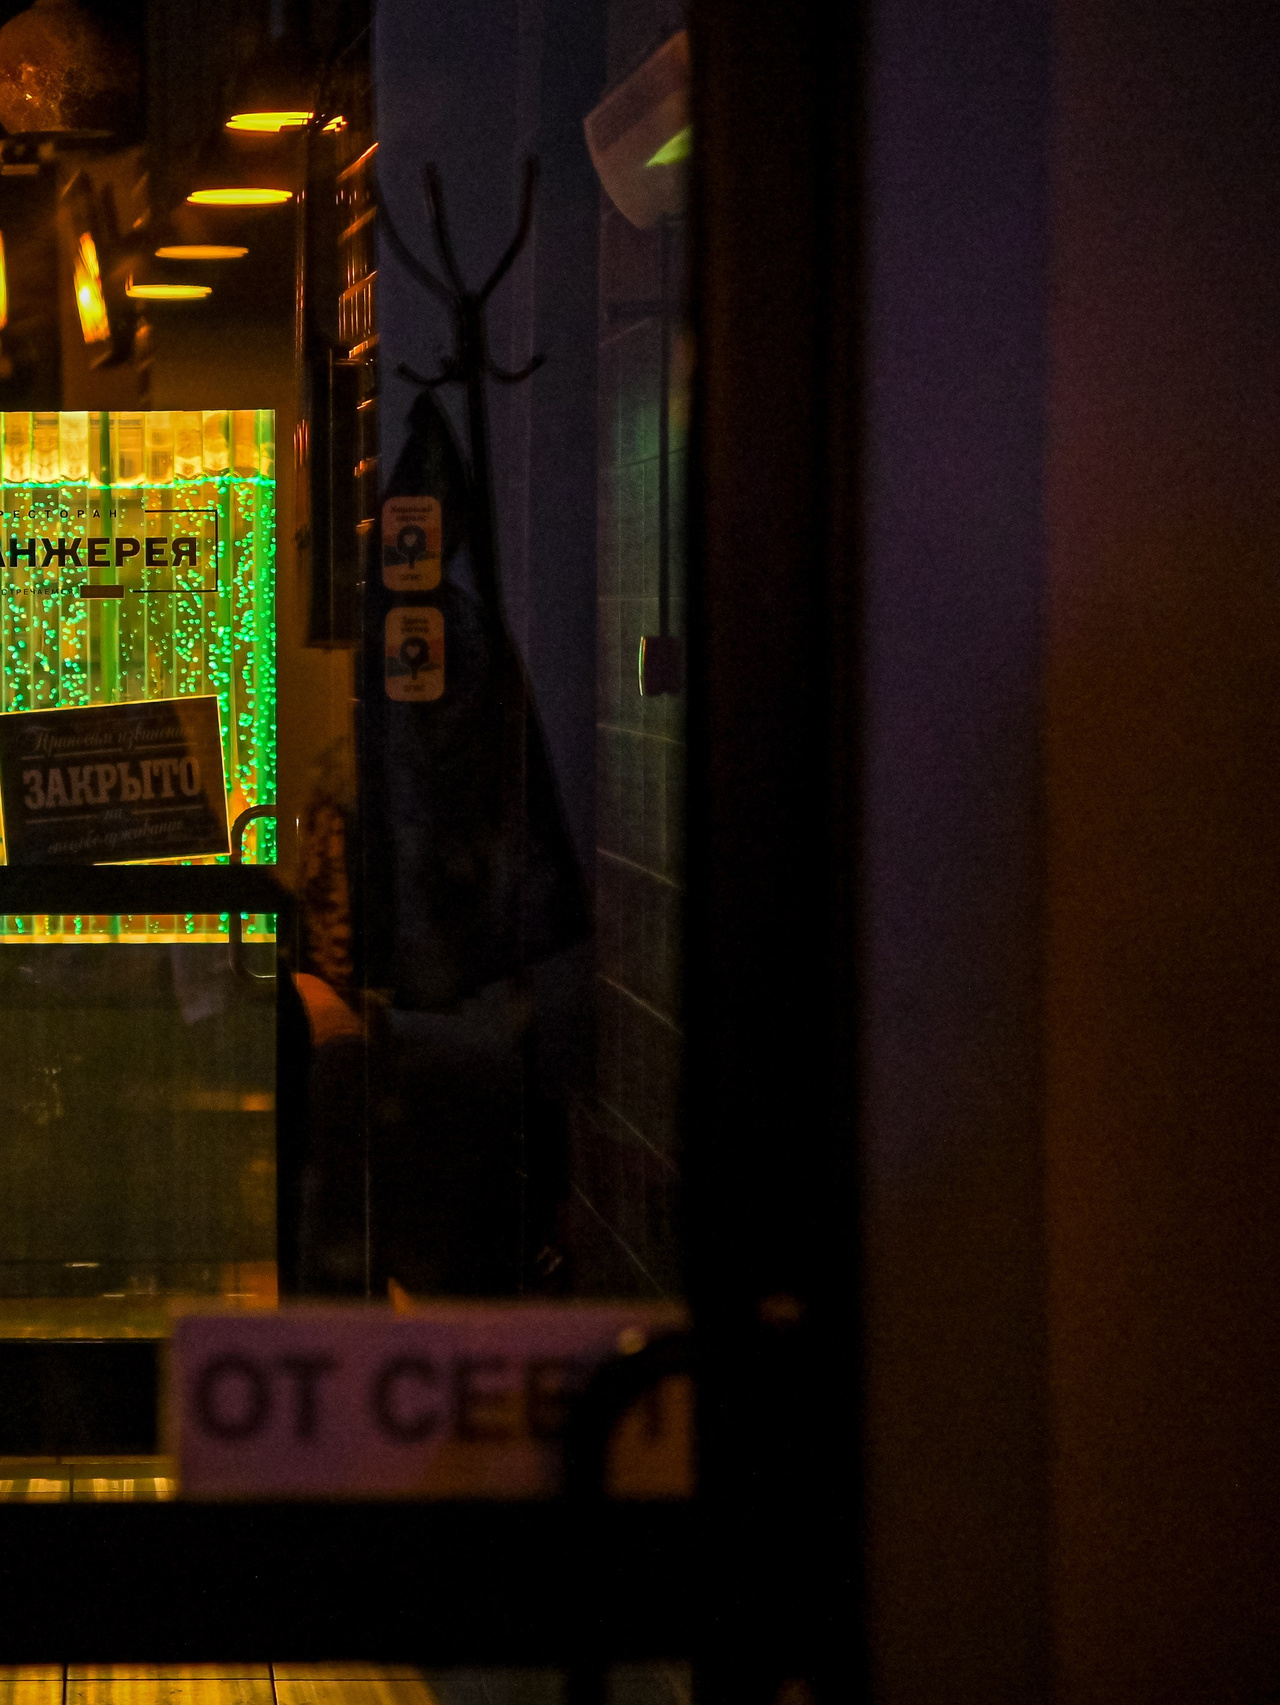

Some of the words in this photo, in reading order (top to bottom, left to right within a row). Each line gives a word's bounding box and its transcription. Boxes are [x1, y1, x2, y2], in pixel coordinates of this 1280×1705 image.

[22, 756, 202, 811] ЗАКРЫТО
[193, 1351, 336, 1444] ОТ
[369, 1352, 666, 1444] СЕБ
